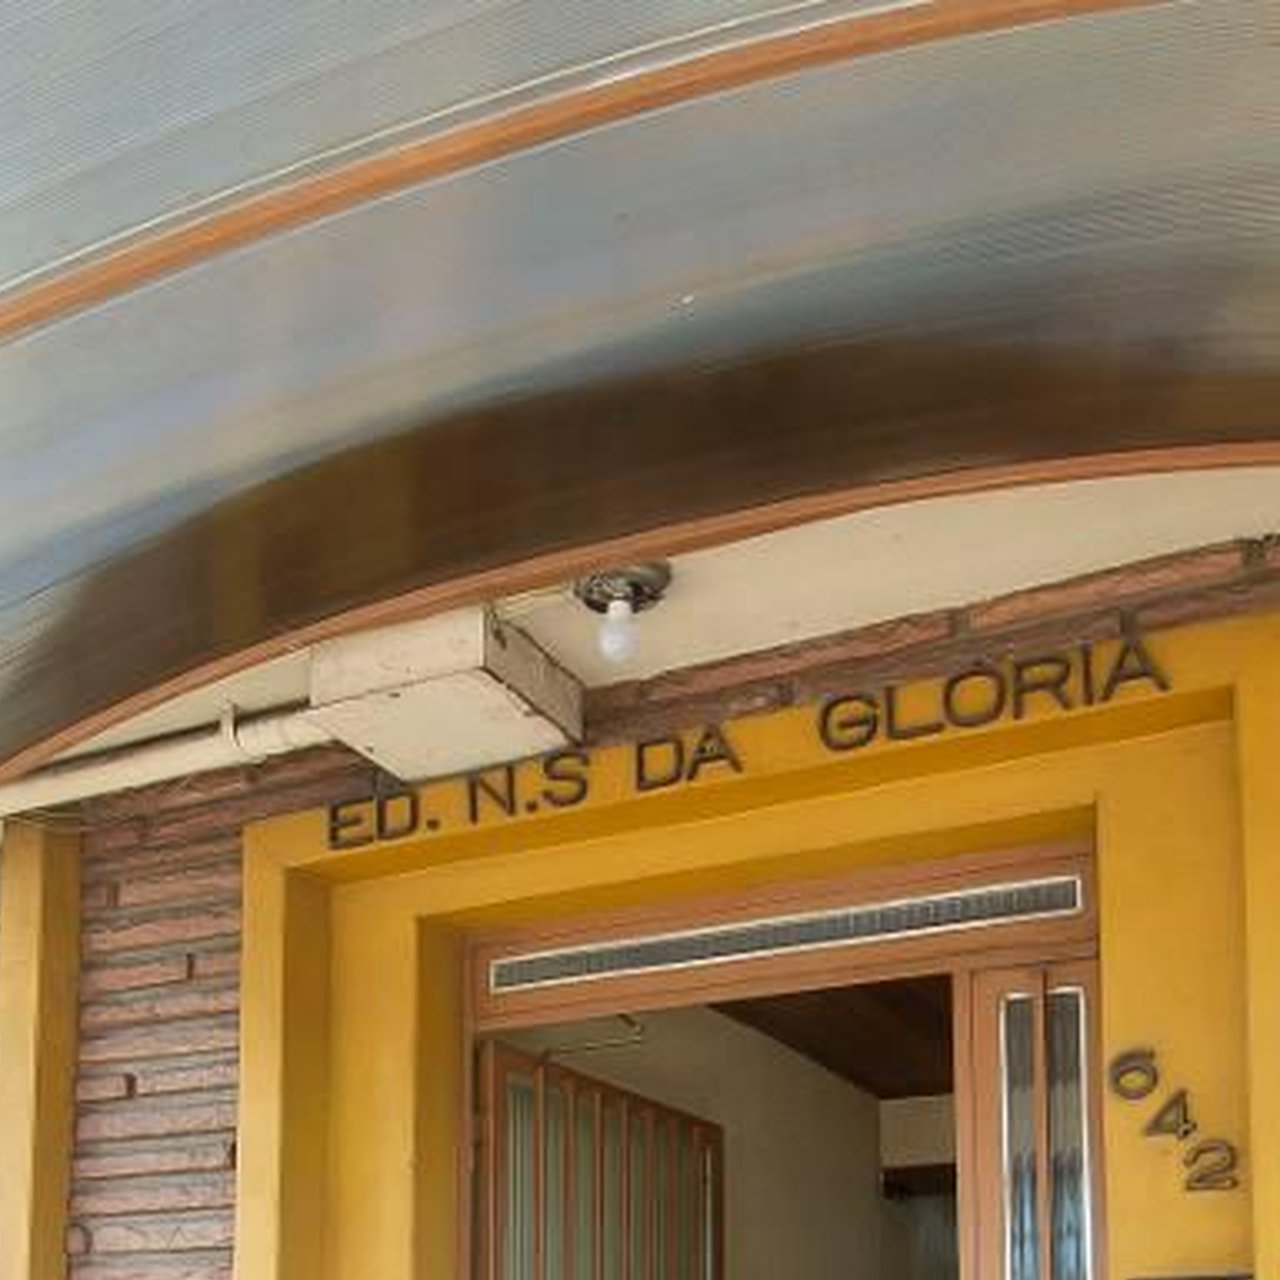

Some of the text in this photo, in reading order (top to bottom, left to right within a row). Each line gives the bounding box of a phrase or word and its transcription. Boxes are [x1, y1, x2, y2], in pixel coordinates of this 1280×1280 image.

[328, 637, 1169, 850] ED. N.S DA GLORIA
[1110, 1048, 1239, 1192] 642
